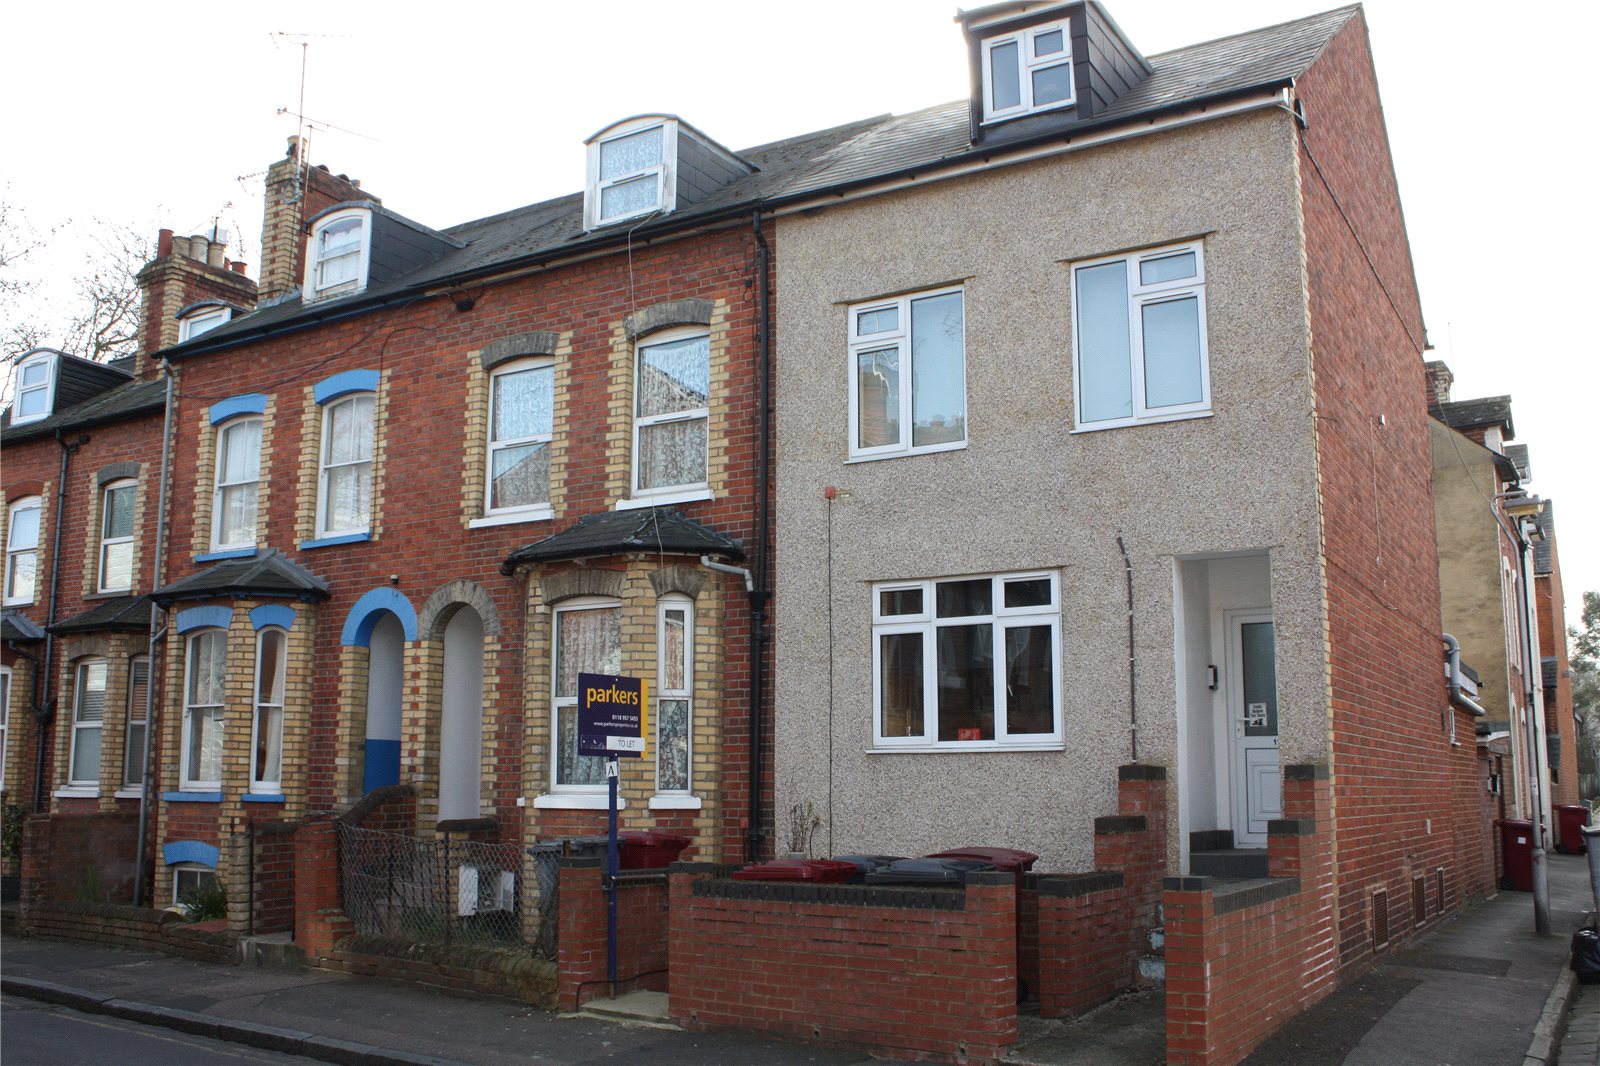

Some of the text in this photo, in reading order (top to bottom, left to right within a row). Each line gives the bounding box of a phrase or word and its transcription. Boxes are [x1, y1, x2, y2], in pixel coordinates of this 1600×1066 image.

[587, 684, 638, 708] parkers
[618, 739, 635, 748] TO LET
[607, 765, 615, 776] A
